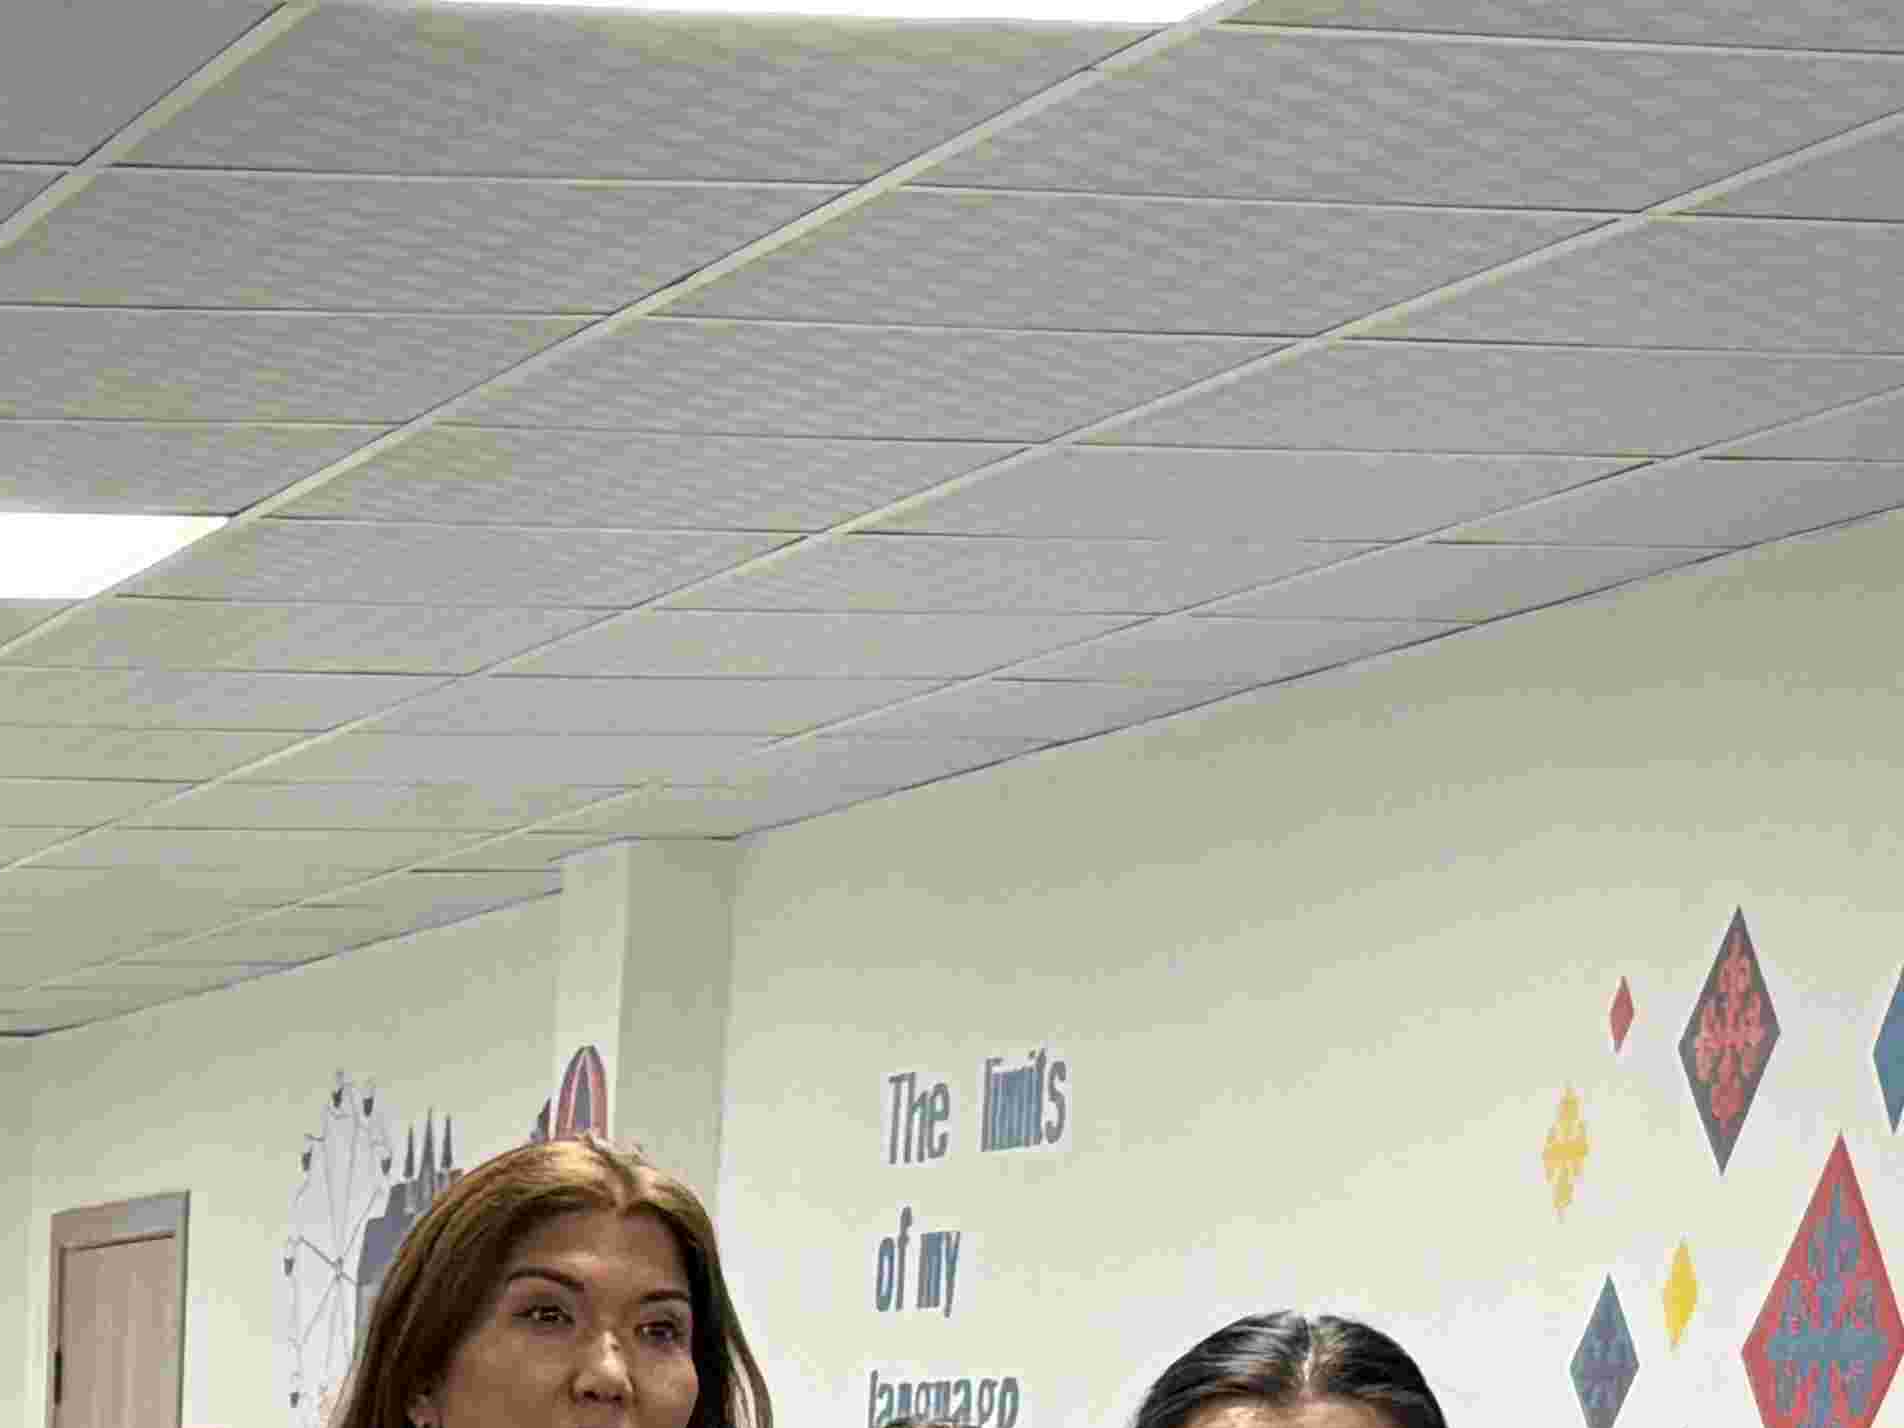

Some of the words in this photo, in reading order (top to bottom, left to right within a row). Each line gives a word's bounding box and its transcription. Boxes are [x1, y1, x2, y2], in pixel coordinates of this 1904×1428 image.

[888, 1070, 950, 1165] The
[876, 1206, 913, 1311] of
[916, 1231, 961, 1318] my
